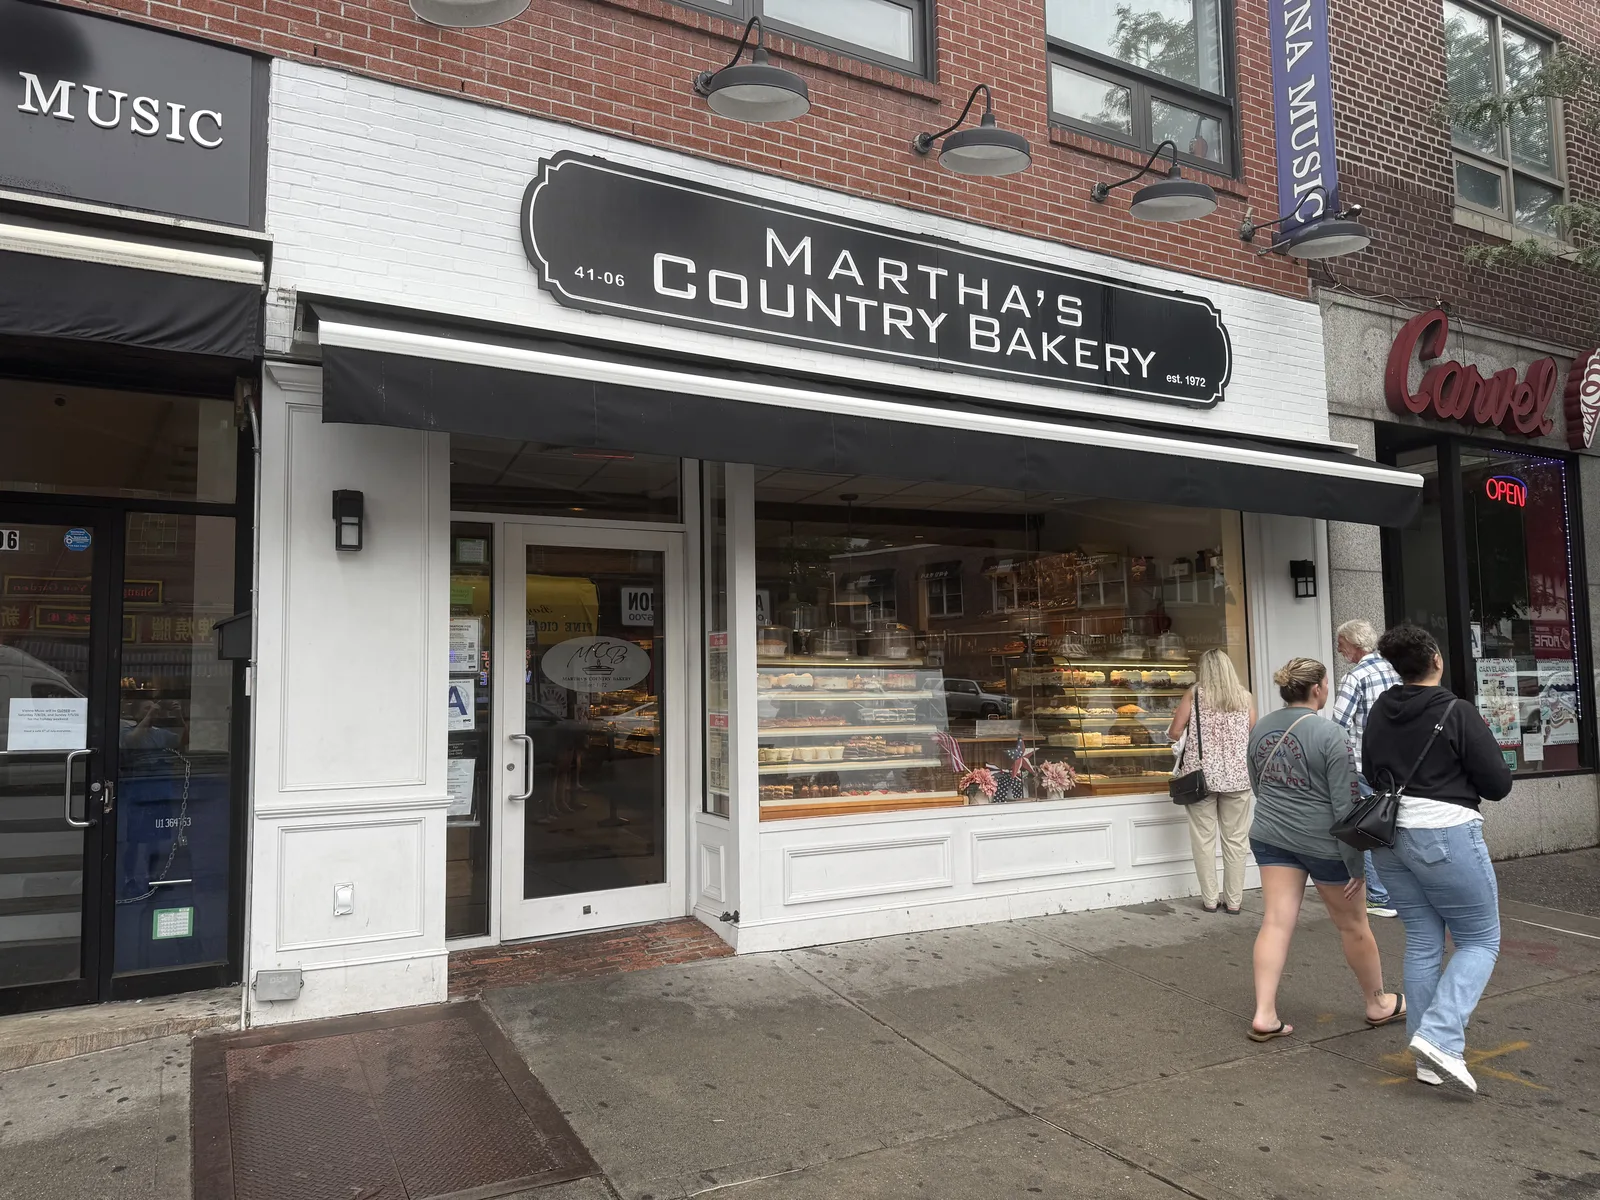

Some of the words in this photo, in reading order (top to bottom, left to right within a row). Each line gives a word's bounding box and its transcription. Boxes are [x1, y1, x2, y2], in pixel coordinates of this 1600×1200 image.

[17, 71, 224, 149] MUSIC
[1288, 74, 1325, 223] MUSIC
[574, 266, 626, 287] 41-06
[765, 227, 1083, 328] MARTHA'S
[653, 252, 948, 344] COUNTRY
[969, 313, 1156, 379] BAKERY
[1166, 373, 1182, 385] est.
[1185, 375, 1206, 388] 1972
[1385, 308, 1558, 438] Carvel
[1486, 478, 1525, 507] OPEN
[1283, 735, 1302, 760] BEER
[1344, 739, 1358, 775] SALTY
